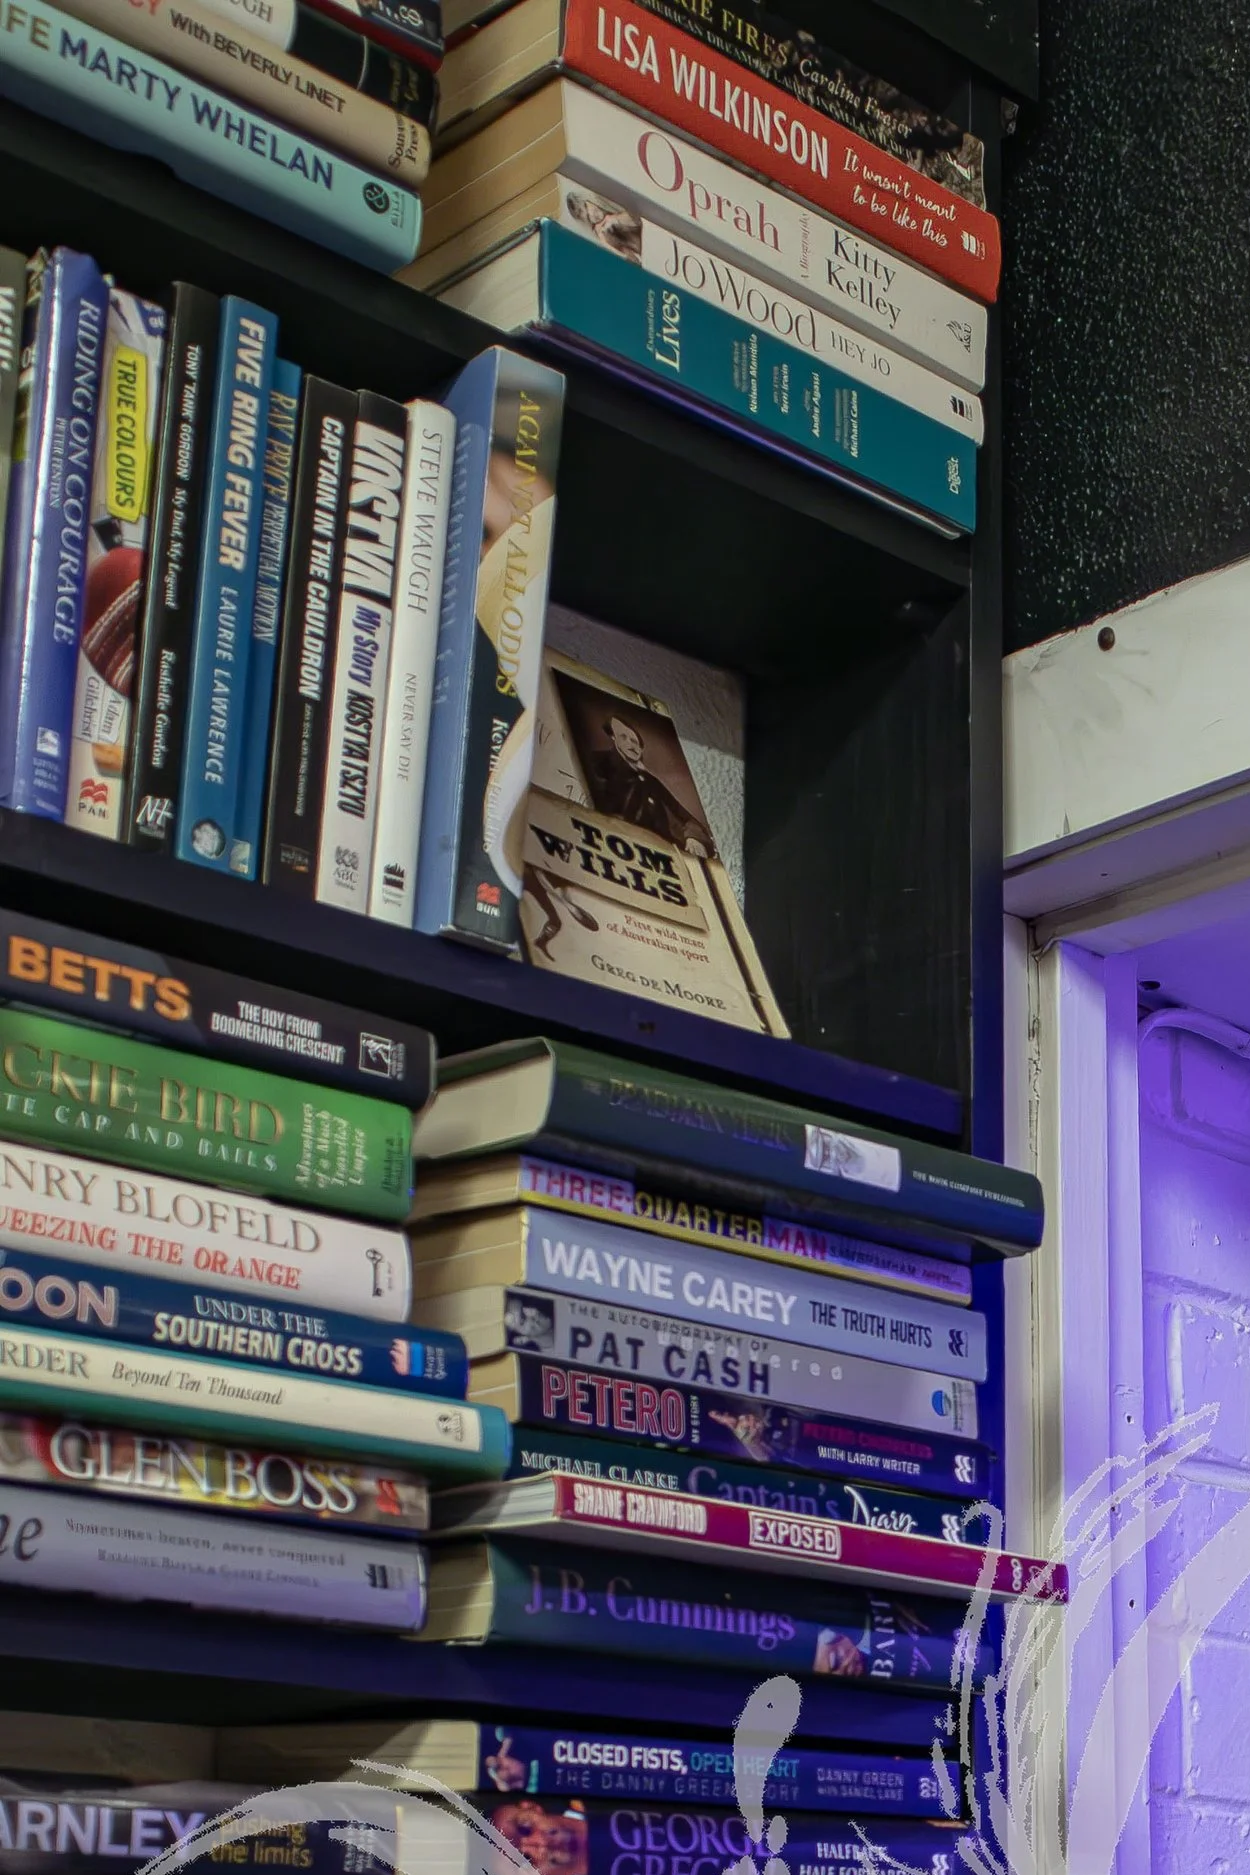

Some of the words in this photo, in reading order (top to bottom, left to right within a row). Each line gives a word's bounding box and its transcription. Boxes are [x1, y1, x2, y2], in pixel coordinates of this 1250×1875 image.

[213, 25, 296, 86] BEVERLY
[295, 75, 347, 114] LINET
[596, 5, 660, 84] LISA
[670, 47, 830, 180] WILKINSON
[59, 29, 183, 112] MARTY
[191, 93, 335, 191] WHELAN
[637, 130, 784, 254] Oprah
[843, 146, 860, 173] It
[862, 161, 914, 202] wasn't
[914, 185, 959, 223] meant
[853, 184, 868, 206] to
[869, 193, 889, 218] be
[891, 201, 918, 231] like
[921, 217, 950, 248] this
[826, 259, 903, 329] Kelley
[832, 230, 897, 291] Kitty
[233, 316, 266, 388] FIVE
[655, 291, 681, 374] Lives
[830, 328, 866, 365] HEY
[870, 349, 893, 377] JO
[116, 358, 137, 415] TRUE
[115, 415, 136, 511] COLOURS
[227, 390, 259, 469] RING
[315, 416, 345, 510] CAPTAIN
[414, 428, 443, 509] STEVE
[219, 469, 254, 572] FEVER
[310, 532, 334, 576] THE
[313, 509, 336, 532] IN
[408, 511, 435, 615] WAUGH
[216, 587, 240, 663] LAURIE
[299, 578, 331, 699] CAULDRON
[204, 668, 234, 786] LAWRENCE
[399, 672, 417, 724] NEVER
[396, 755, 411, 783] DIE
[399, 727, 413, 756] SAY
[78, 801, 107, 819] PAN
[529, 823, 689, 908] WILLS
[571, 816, 677, 880] TOM
[7, 935, 192, 1022] BETTS
[211, 1012, 286, 1049] BOOMERANG
[286, 1034, 345, 1064] CRESCENT
[238, 1001, 259, 1022] THE
[261, 1007, 286, 1028] BOY
[286, 1014, 321, 1038] FROM
[113, 1180, 322, 1253] BLOFELD
[127, 1232, 183, 1266] THE
[194, 1247, 302, 1291] ORANGE
[542, 1239, 673, 1298] WAYNE
[683, 1272, 797, 1325] CAREY
[154, 1313, 284, 1360] SOUTHERN
[286, 1336, 362, 1375] CROSS
[569, 1328, 645, 1370] PAT
[664, 1344, 772, 1395] CASH
[810, 1301, 837, 1328] THE
[841, 1307, 886, 1338] TRUTH
[889, 1317, 932, 1349] HURTS
[541, 1365, 686, 1442] PETERO
[50, 1425, 213, 1494] GLEN
[224, 1452, 357, 1515] BOSS
[754, 1518, 838, 1554] EXPOSED
